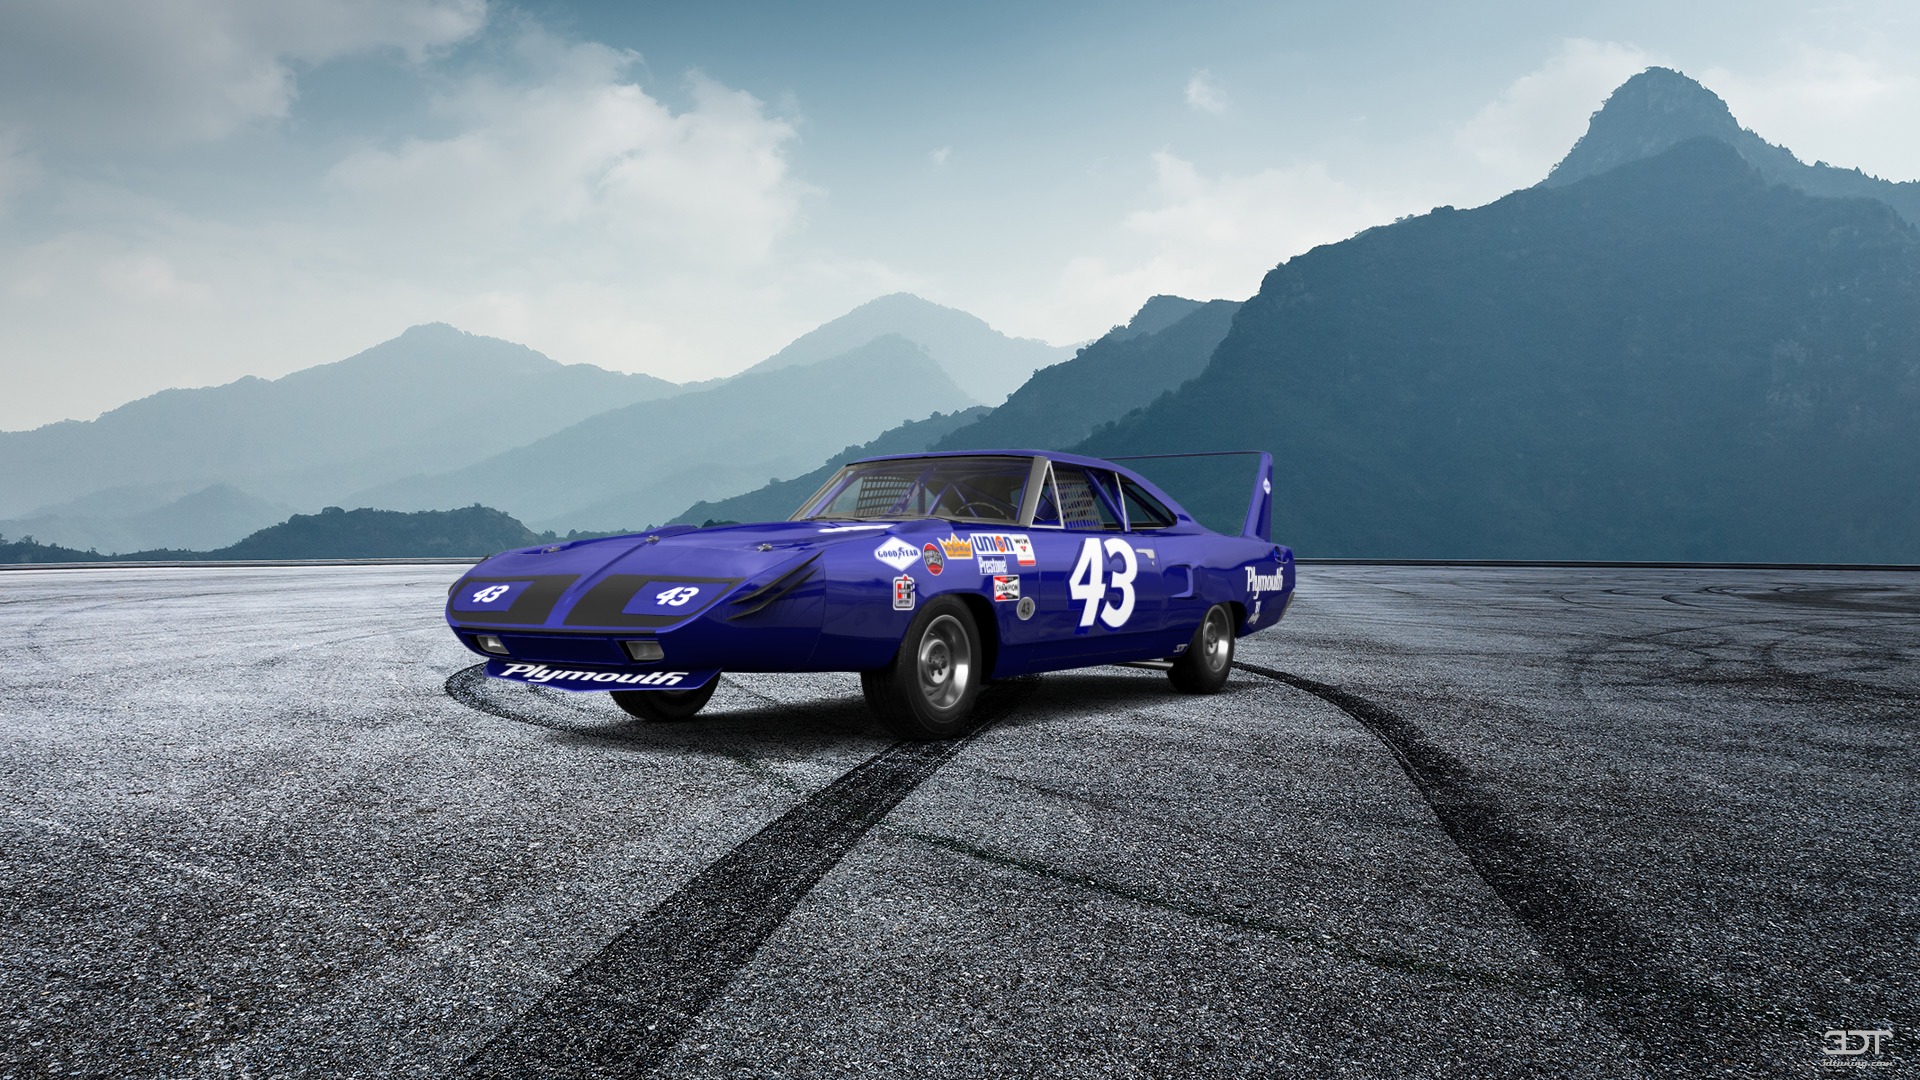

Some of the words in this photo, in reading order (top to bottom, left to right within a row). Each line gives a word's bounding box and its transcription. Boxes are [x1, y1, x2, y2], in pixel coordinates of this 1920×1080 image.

[973, 535, 1015, 552] UNION
[877, 547, 919, 560] GOODYEAR
[978, 556, 1008, 574] Prestone
[1069, 537, 1138, 628] 43
[1245, 566, 1284, 600] Plymouth
[472, 585, 510, 603] 43
[655, 586, 700, 606] 43
[1021, 602, 1031, 615] 43
[500, 663, 689, 686] Plymouth
